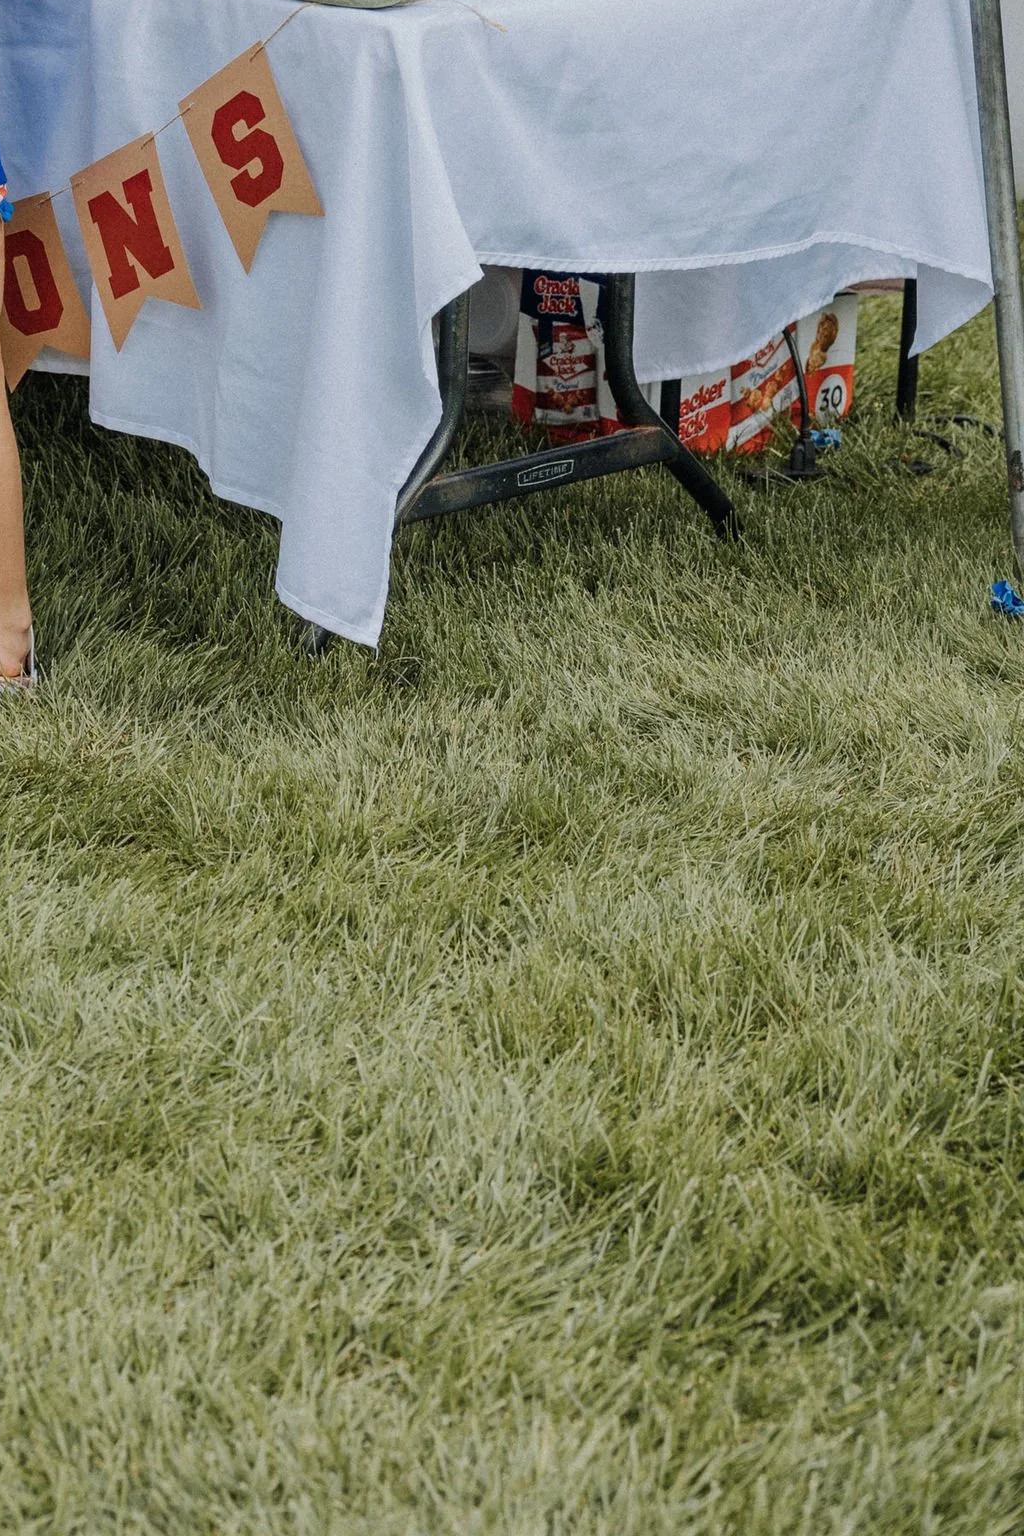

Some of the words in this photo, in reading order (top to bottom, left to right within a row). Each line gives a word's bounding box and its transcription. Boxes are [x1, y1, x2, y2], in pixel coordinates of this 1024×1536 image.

[537, 295, 578, 316] Jack
[819, 385, 843, 411] 30
[523, 463, 568, 483] LIFETIME
